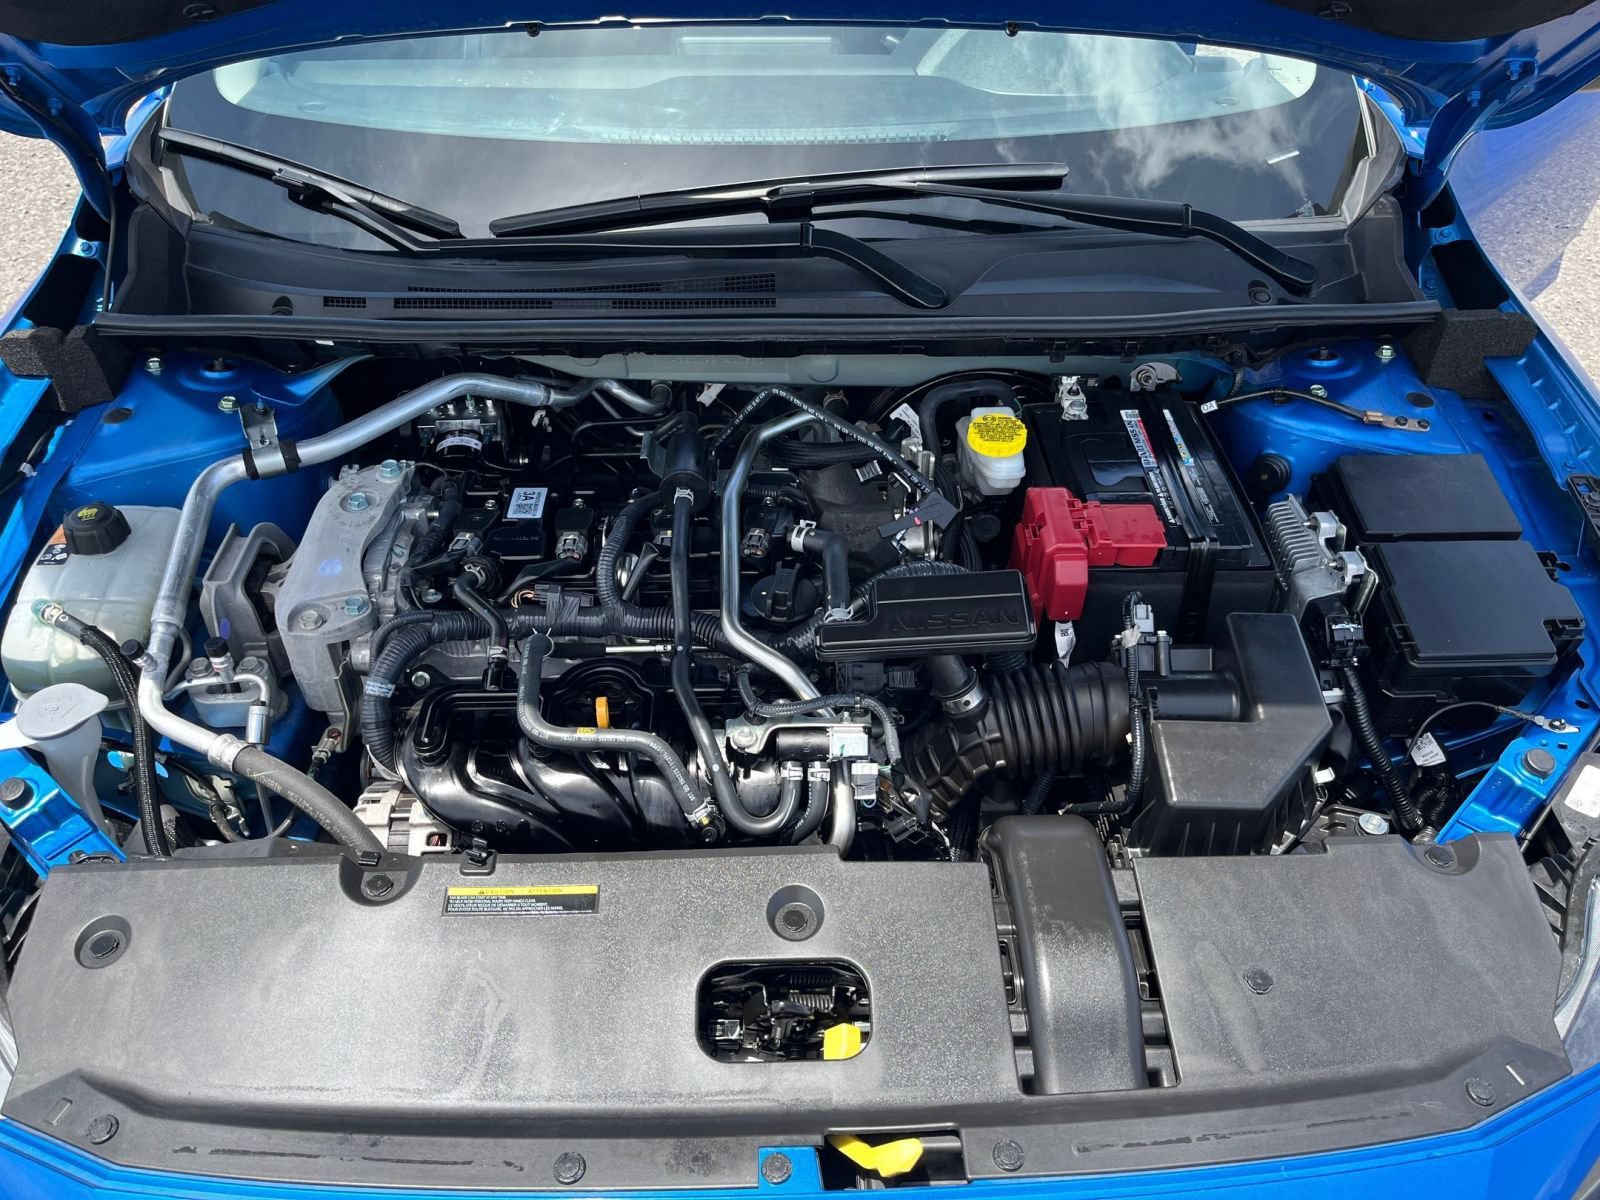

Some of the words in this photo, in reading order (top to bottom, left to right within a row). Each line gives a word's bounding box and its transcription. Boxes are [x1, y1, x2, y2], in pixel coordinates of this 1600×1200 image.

[1126, 420, 1141, 444] NISSAN
[521, 491, 536, 502] 3A
[892, 607, 1021, 632] NISSAN
